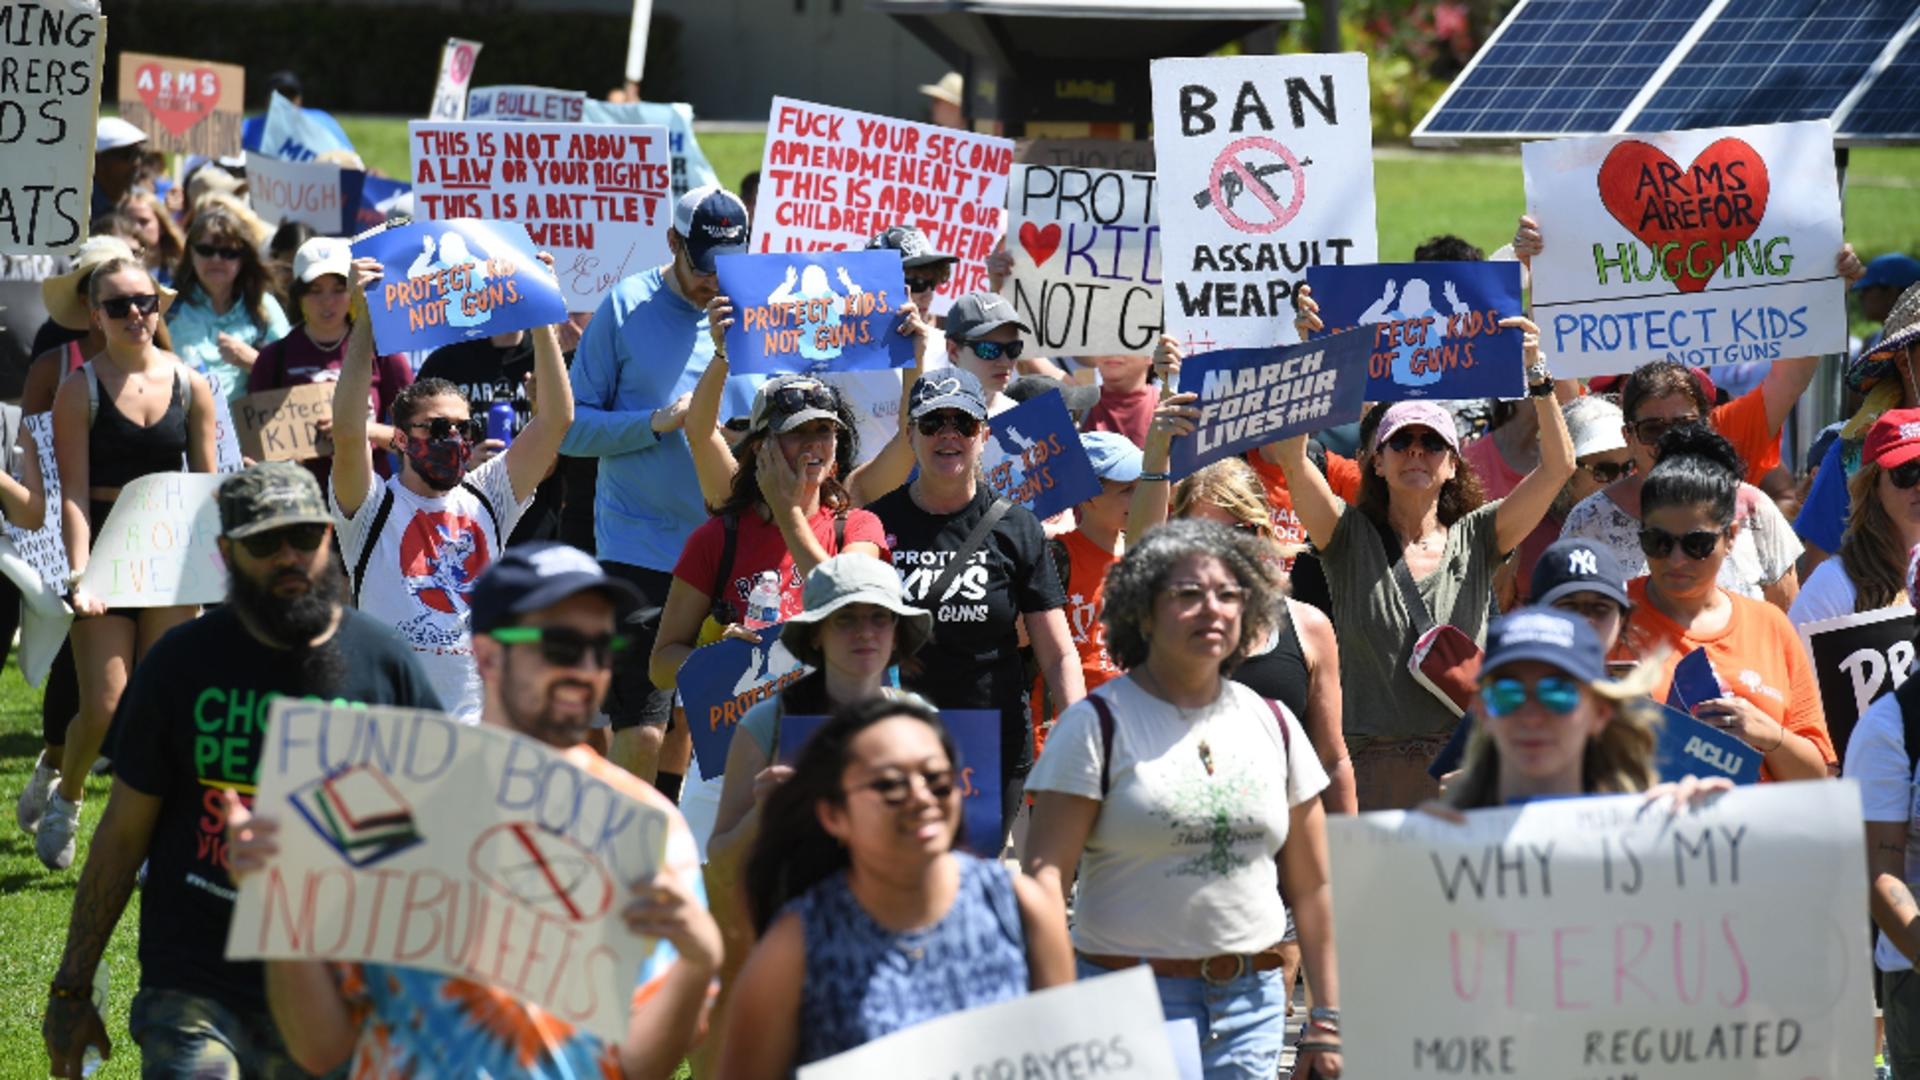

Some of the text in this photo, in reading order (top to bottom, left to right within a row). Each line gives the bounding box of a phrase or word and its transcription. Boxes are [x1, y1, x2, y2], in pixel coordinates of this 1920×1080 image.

[1, 57, 90, 95] RERS
[137, 69, 216, 96] ARMS
[496, 92, 584, 122] BULLETS
[1178, 74, 1339, 137] BAN
[415, 130, 652, 163] THIS IS NOT ABOUT
[777, 106, 1013, 177] FUCK YOUR SECOND
[417, 158, 437, 184] A
[438, 157, 494, 184] LAW
[502, 159, 528, 183] OR
[532, 159, 589, 186] YOUR
[593, 161, 670, 190] RIGHTS
[1634, 160, 1747, 201] ARMS
[420, 192, 658, 227] THIS IS A BATTLE!
[769, 169, 1001, 229] THIS IS ABOUT OUR
[524, 222, 595, 250] WEEN
[915, 218, 996, 262] THEIR
[1593, 235, 1794, 286] HUGGING
[384, 262, 476, 312] PROTECT
[408, 279, 525, 335] NOT GUNS.
[742, 289, 895, 333] PROTECT KIDS.
[763, 319, 874, 358] NOT GUNS.
[1013, 278, 1111, 350] NOT
[1552, 305, 1809, 354] PROTECT KIDS
[1200, 349, 1325, 402] MARCH
[1409, 342, 1480, 376] GUNS.
[1198, 368, 1338, 429] FOR OUR
[1196, 405, 1287, 457] LIVES
[937, 604, 989, 623] GUNS
[1683, 735, 1744, 775] ACLU
[276, 705, 671, 885] FUND BOOKS
[1429, 824, 1748, 903] WHY IS MY
[1448, 912, 1751, 1012] UTERUS
[1412, 1017, 1804, 1077] MORE REGULATED
